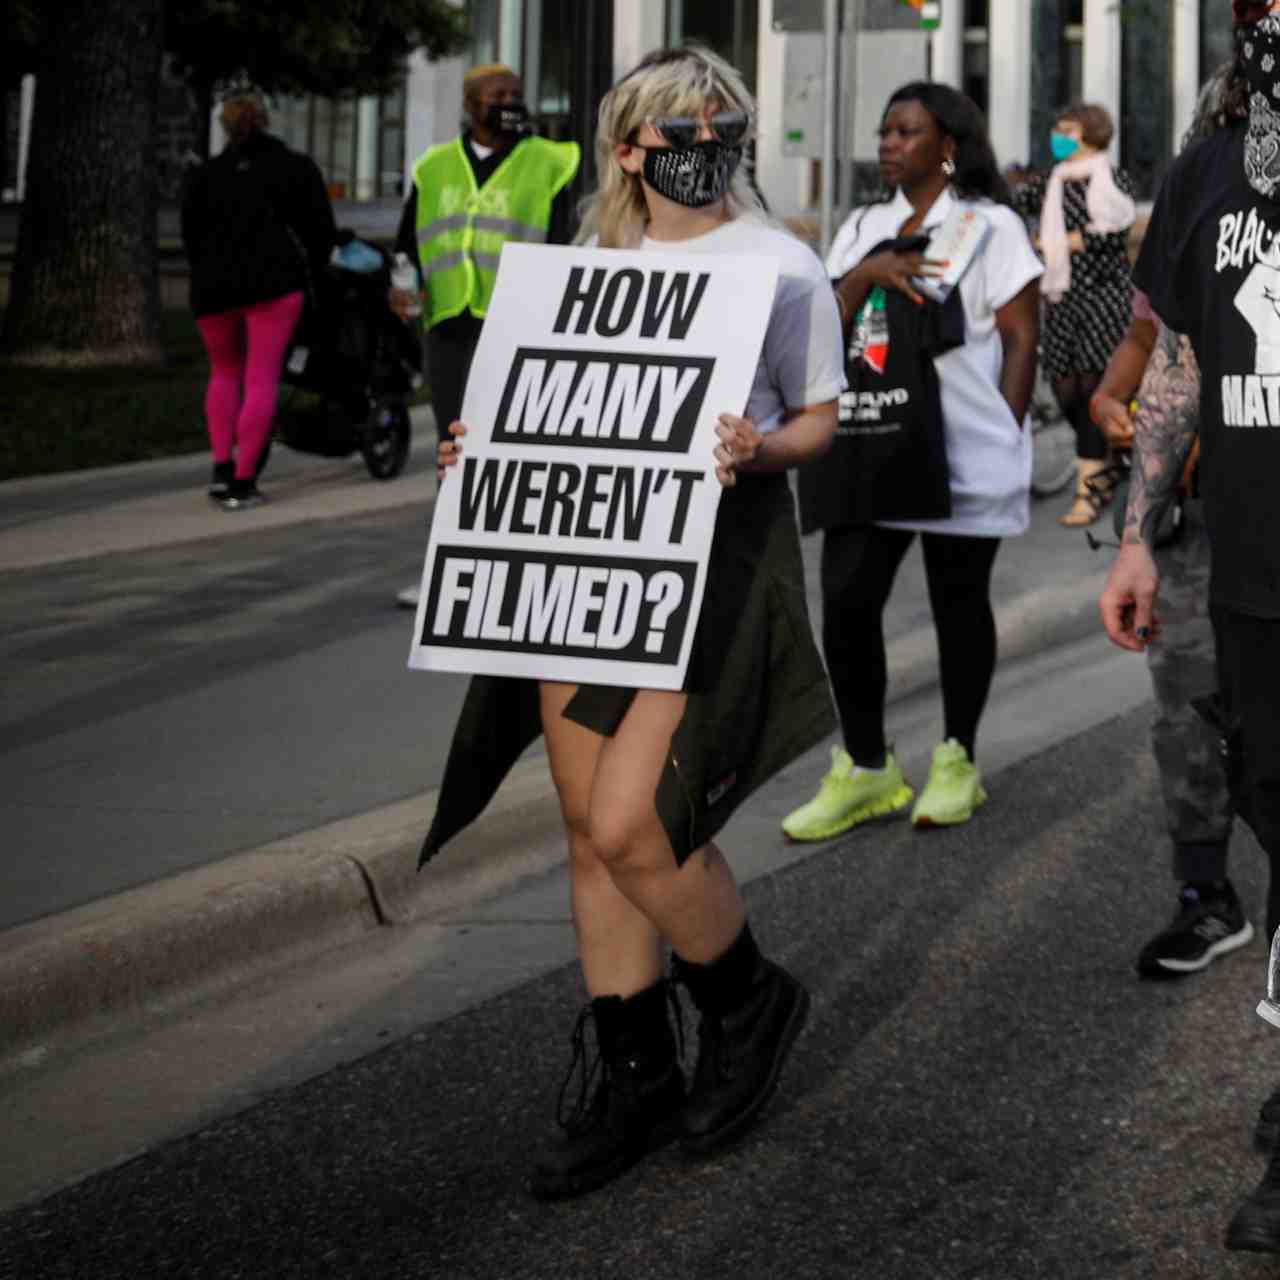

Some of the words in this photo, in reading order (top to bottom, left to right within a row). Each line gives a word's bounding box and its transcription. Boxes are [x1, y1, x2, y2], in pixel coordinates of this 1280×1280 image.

[552, 266, 711, 341] HOW
[504, 358, 701, 442] MANY
[458, 457, 704, 544] WEREN'T
[432, 557, 685, 654] FILMED?
